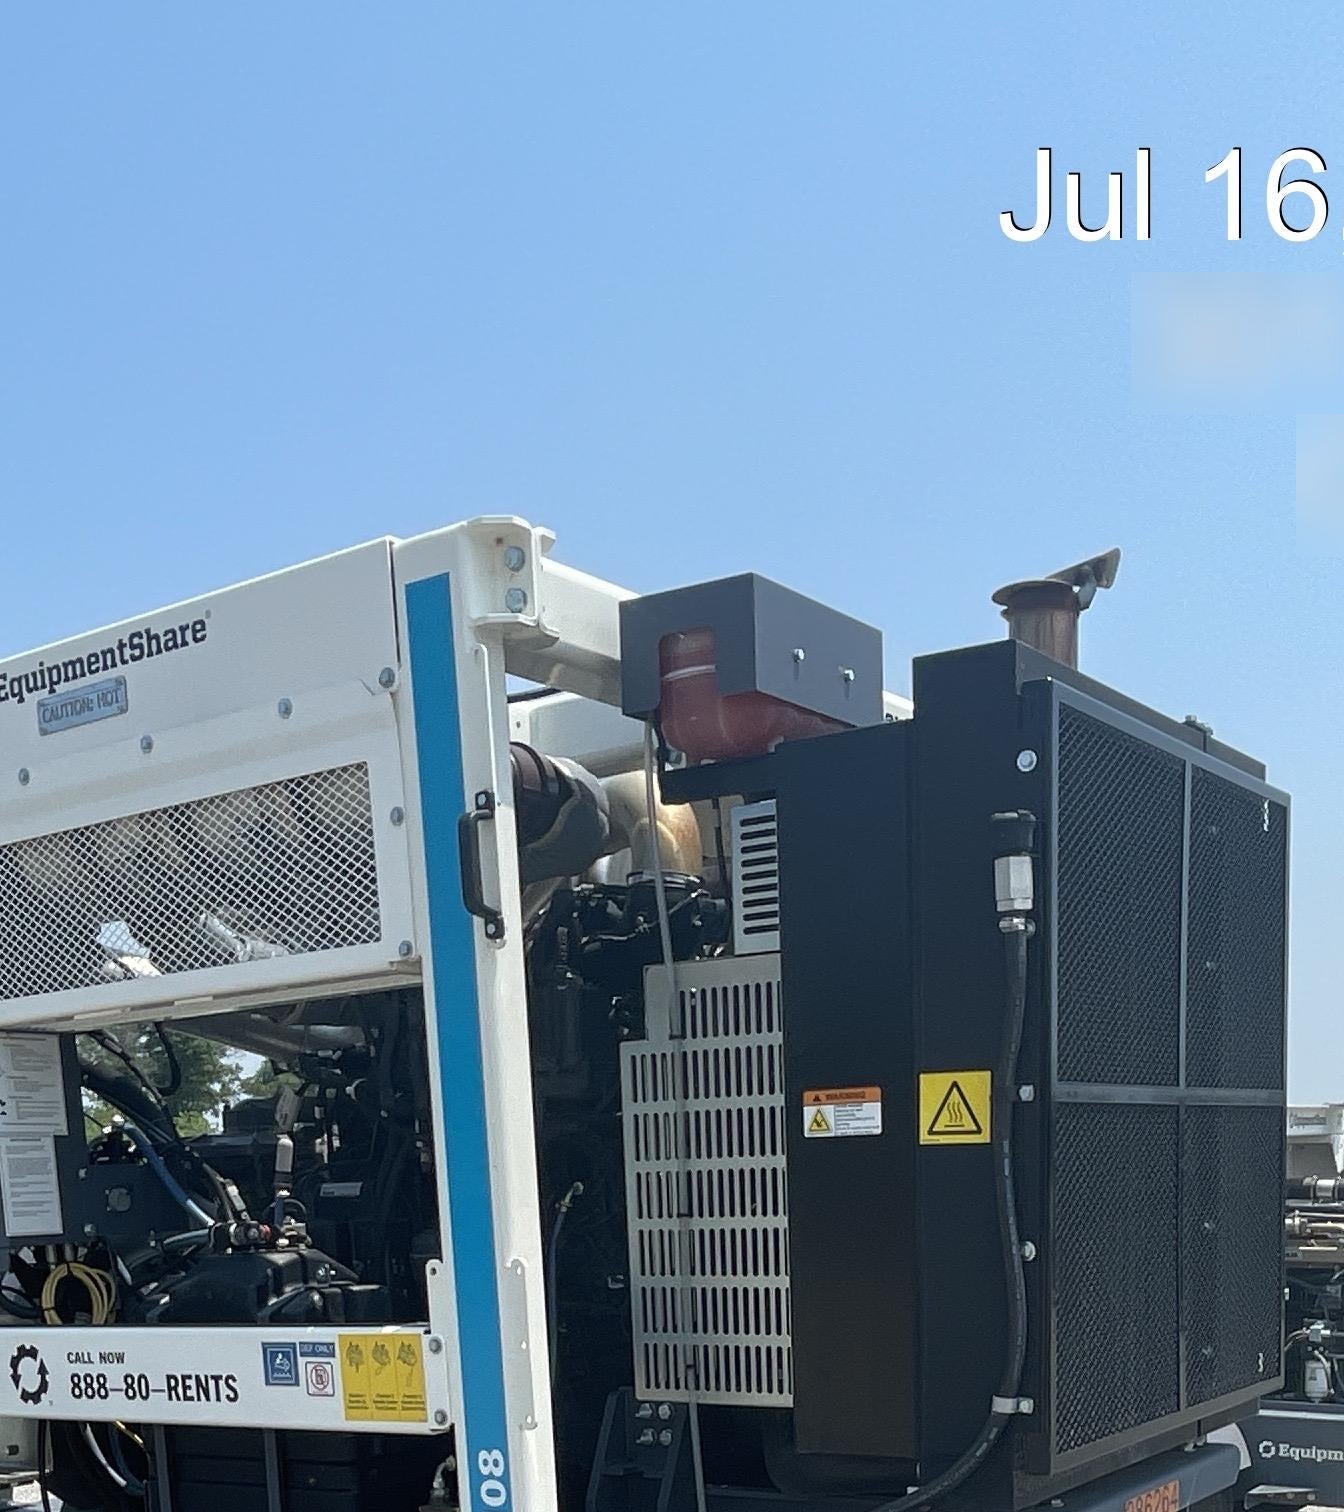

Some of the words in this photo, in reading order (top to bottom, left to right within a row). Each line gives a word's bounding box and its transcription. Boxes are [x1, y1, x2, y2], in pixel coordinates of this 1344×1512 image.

[67, 1351, 94, 1364] CALL
[99, 1351, 125, 1364] NOW
[71, 1373, 239, 1403] 888-80-RENTS
